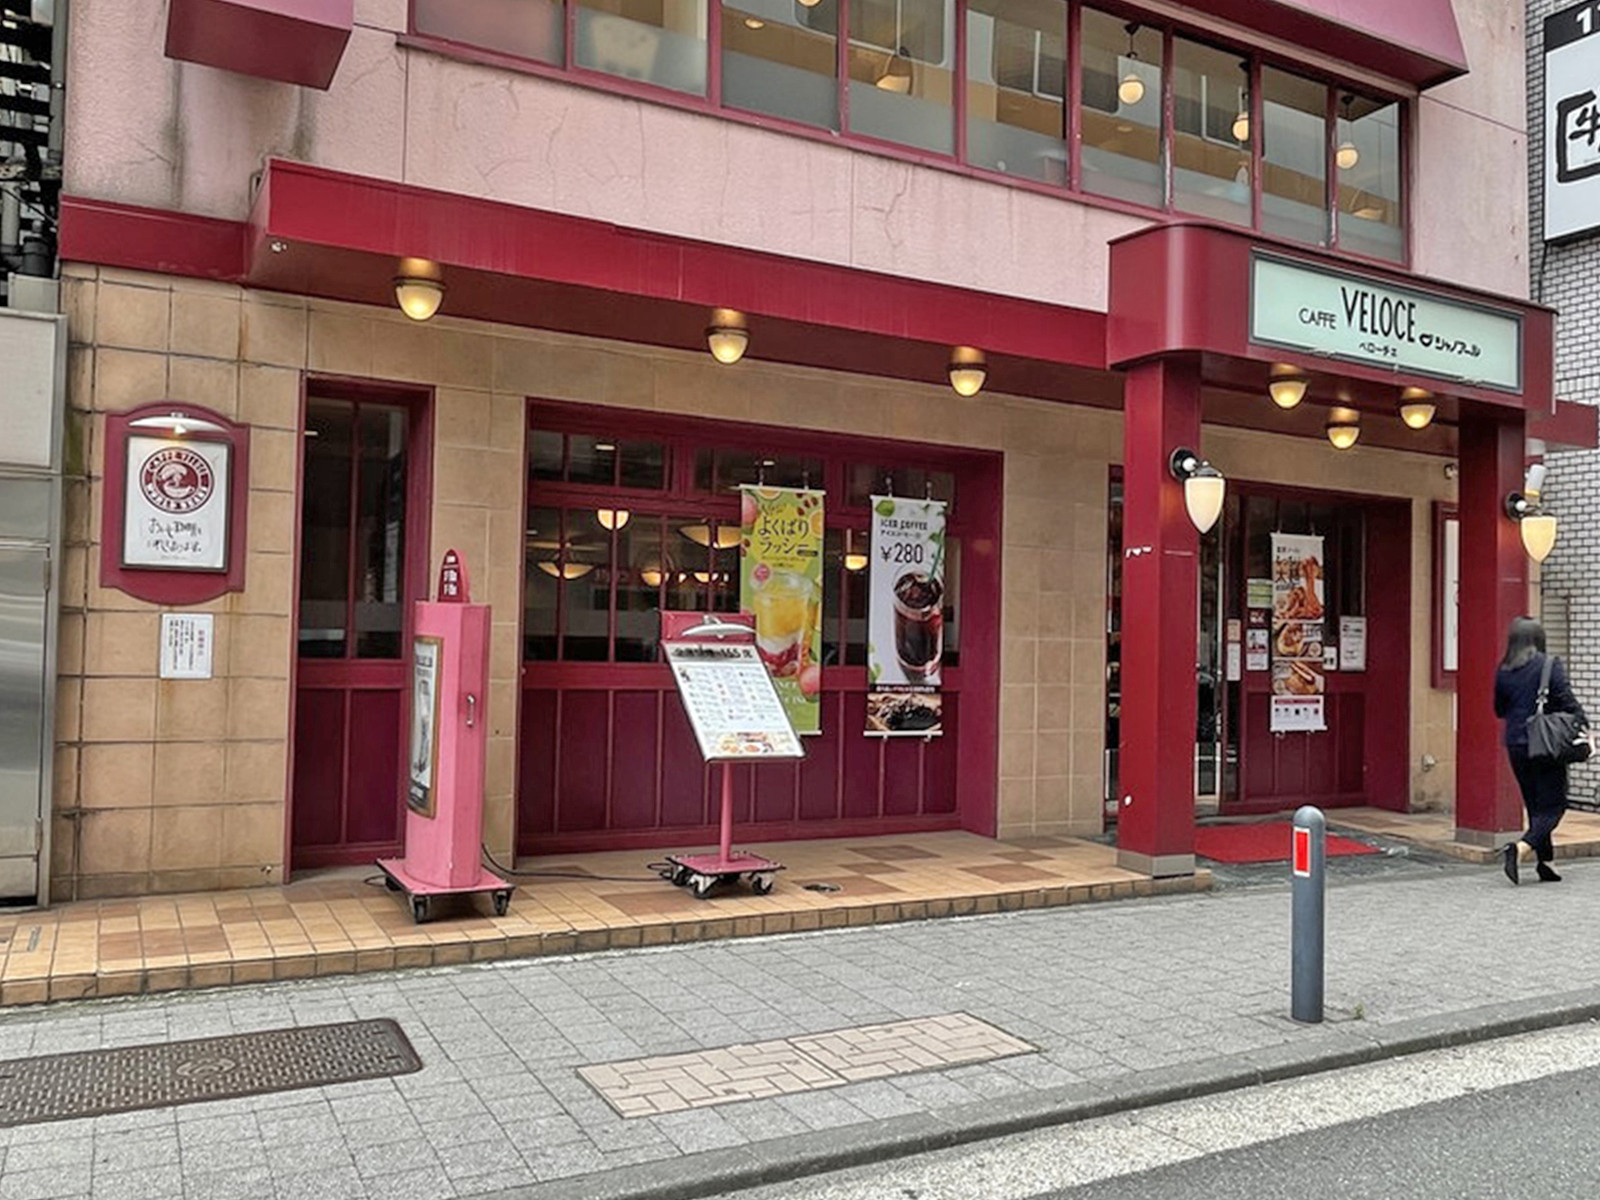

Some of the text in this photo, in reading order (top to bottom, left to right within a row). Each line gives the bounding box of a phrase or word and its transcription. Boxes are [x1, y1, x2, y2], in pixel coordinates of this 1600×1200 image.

[1576, 3, 1600, 34] 1
[1299, 286, 1416, 343] CAFFE VELOCE
[1359, 341, 1398, 358] ベローチェ
[1434, 336, 1481, 358] シャノアール
[758, 516, 810, 539] よくばり
[759, 536, 811, 555] ラッシー
[880, 542, 924, 565] ¥280
